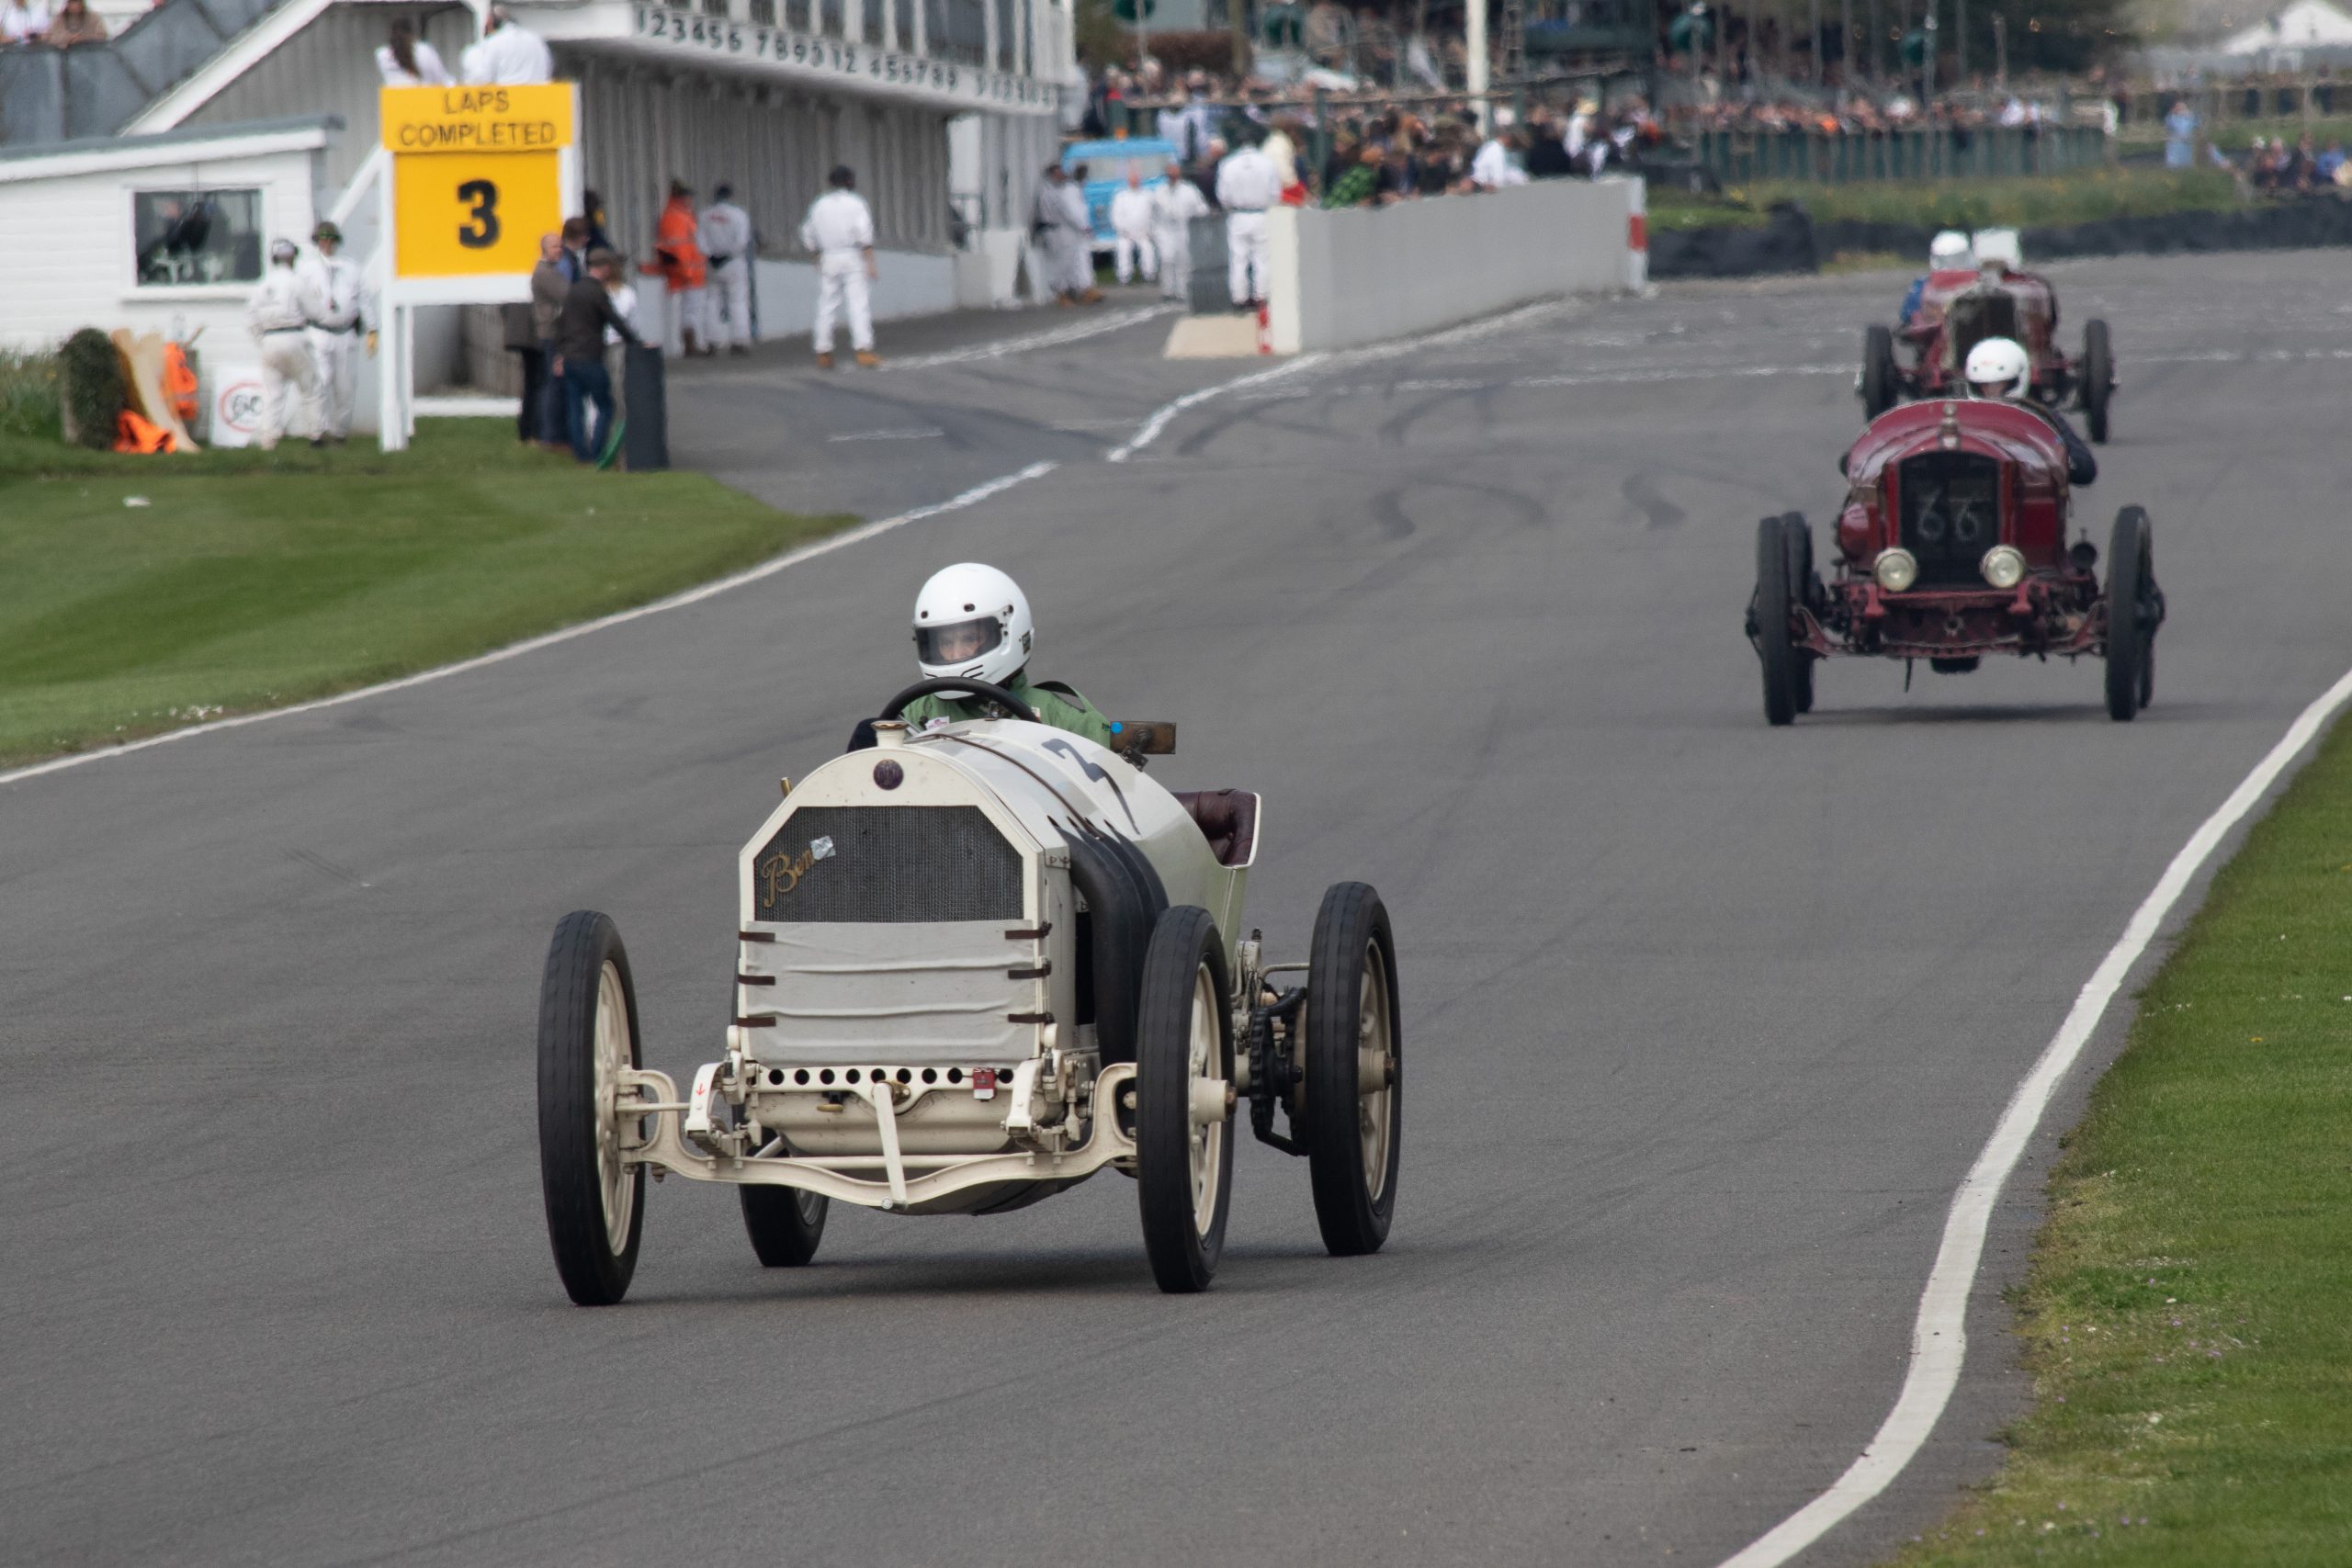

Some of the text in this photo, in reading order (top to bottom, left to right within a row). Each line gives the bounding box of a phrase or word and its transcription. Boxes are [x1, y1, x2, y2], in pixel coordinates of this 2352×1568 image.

[443, 90, 511, 115] LAPS
[399, 121, 557, 147] COMPLETED
[457, 178, 501, 249] 3
[1917, 485, 1979, 543] 66
[761, 847, 817, 908] Ben
